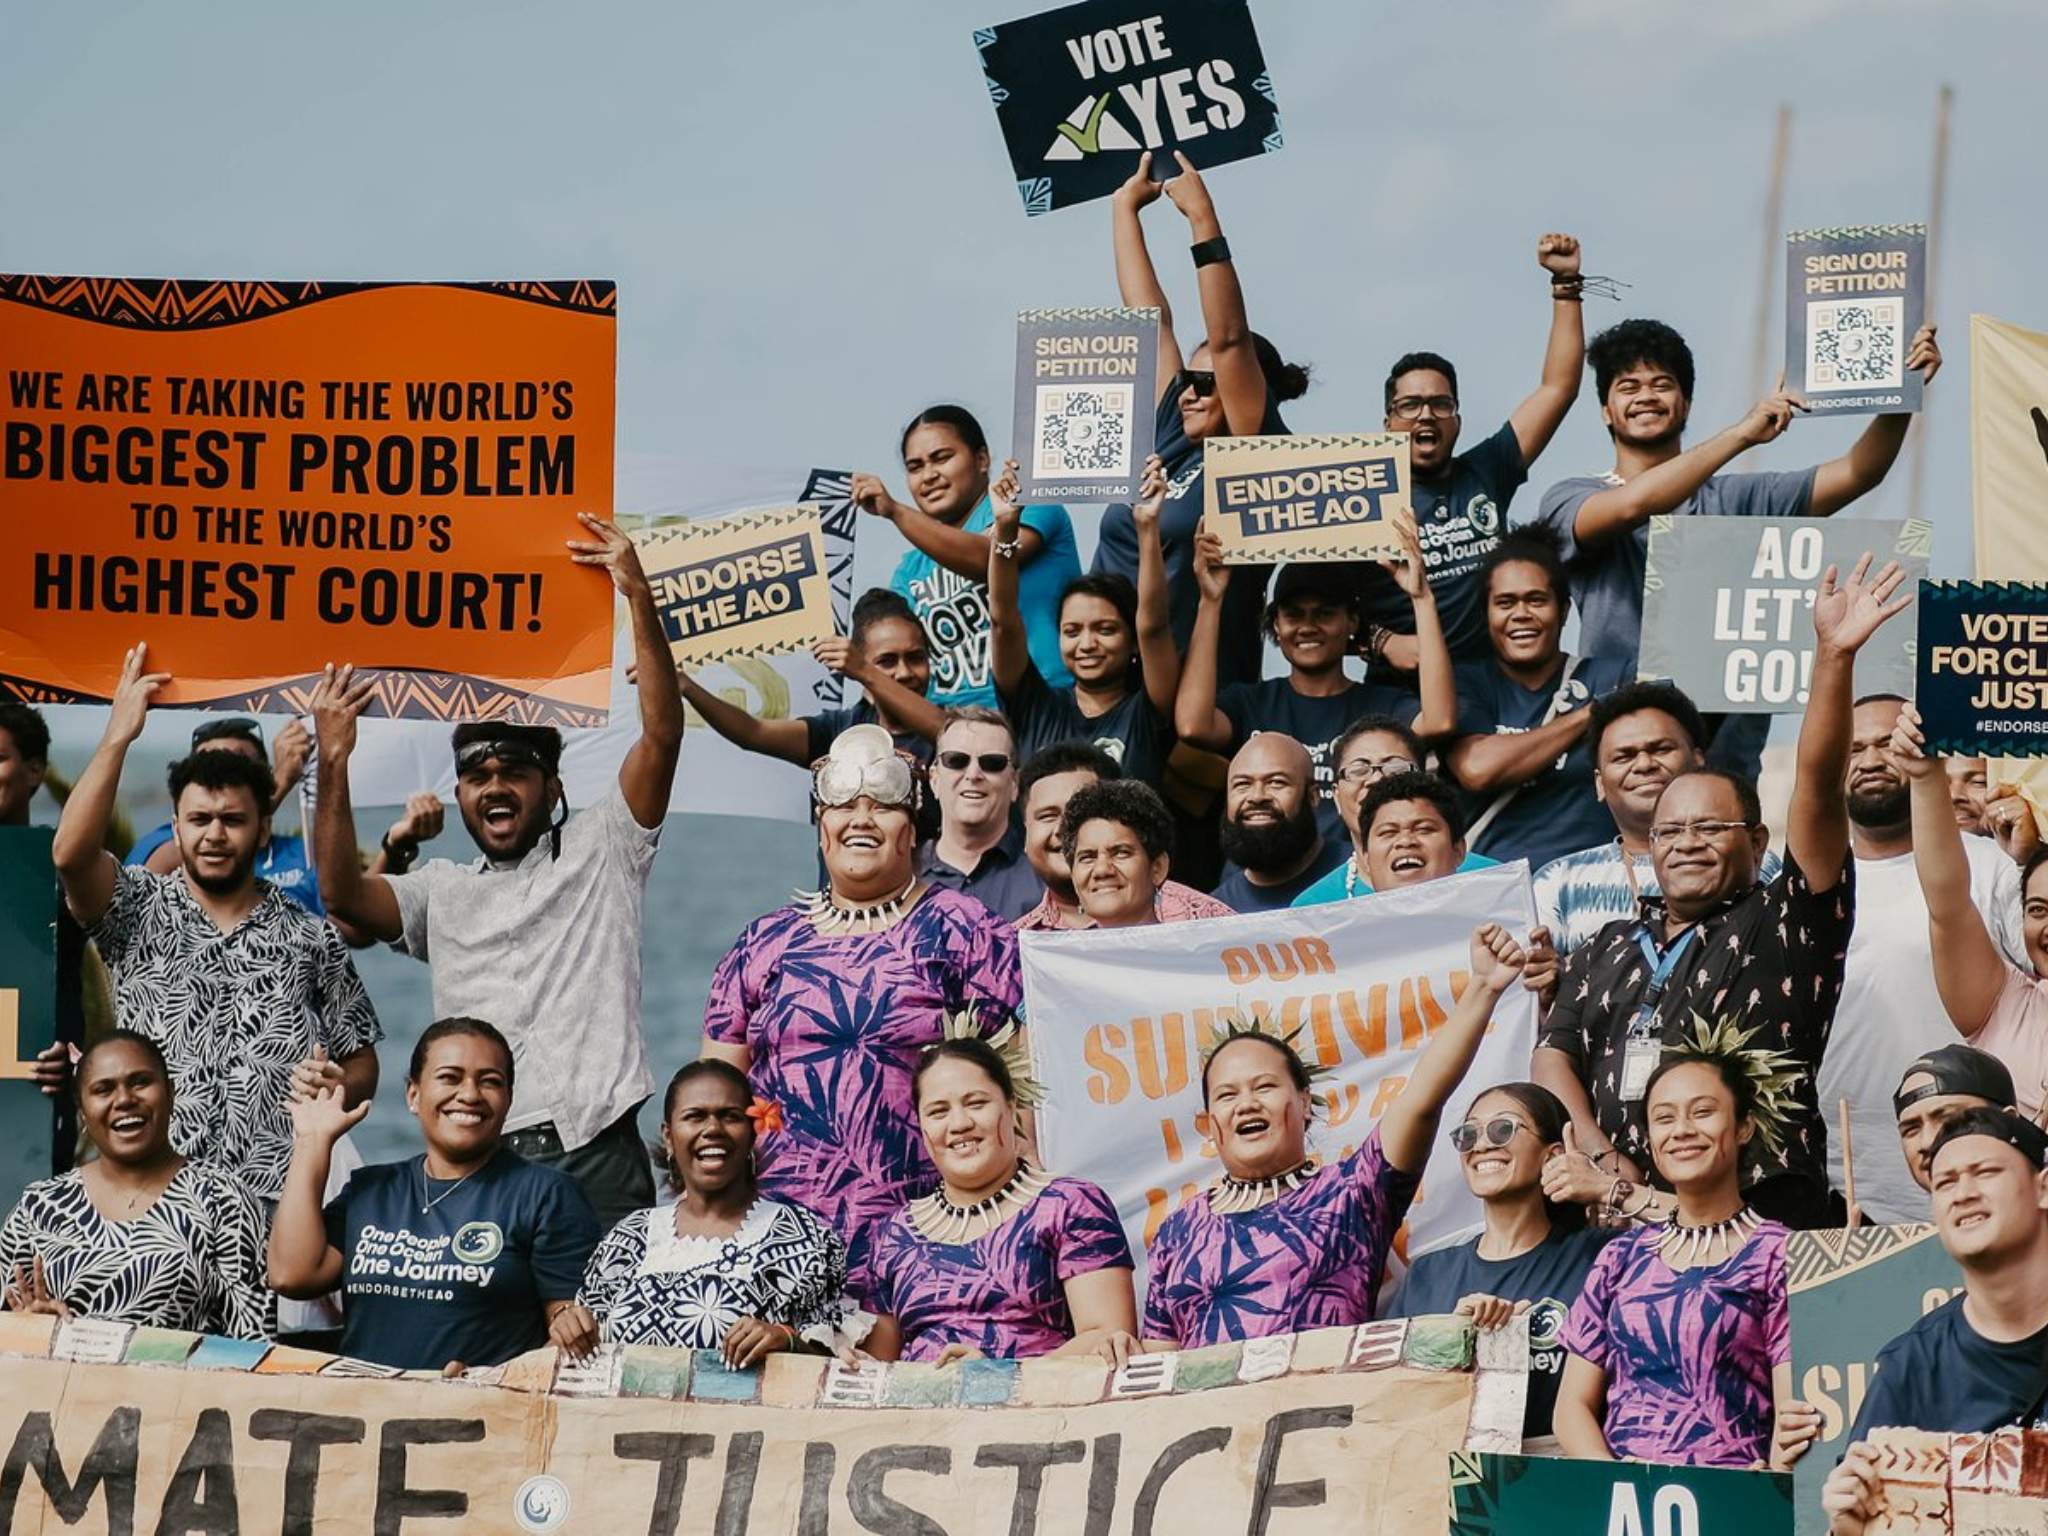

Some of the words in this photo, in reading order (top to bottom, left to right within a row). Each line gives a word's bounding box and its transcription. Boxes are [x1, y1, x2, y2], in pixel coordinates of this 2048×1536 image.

[1066, 15, 1172, 80] VOTE
[1118, 59, 1246, 149] YES
[1804, 254, 1857, 274] SIGN
[1859, 252, 1908, 270] OUR
[1805, 272, 1906, 294] PETITION
[1035, 336, 1089, 356] SIGN
[1090, 336, 1138, 355] OUR
[1036, 357, 1137, 377] PETITION
[9, 370, 63, 411] WE
[76, 373, 152, 414] ARE
[166, 377, 305, 419] TAKING
[320, 381, 391, 421] THE
[406, 380, 574, 422] WORLD'S
[4, 421, 266, 491] BIGGEST
[289, 433, 576, 497] PROBLEM
[1031, 485, 1129, 498] #ENDORSETHEAO
[1225, 463, 1389, 506] ENDORSE
[131, 502, 178, 541] TO
[193, 505, 264, 545] THE
[278, 509, 452, 554] WORLD'S
[1250, 504, 1317, 532] THE
[1323, 497, 1370, 524] AO
[1443, 537, 1502, 562] Journe
[1751, 526, 1824, 581] AO
[33, 552, 295, 622] HIGHEST
[317, 566, 543, 633] COURT!
[649, 543, 806, 607] ENDORSE
[670, 594, 740, 636] THE
[744, 582, 791, 619] AO
[1714, 588, 1817, 641] LET'
[1961, 614, 2048, 642] VOTE
[1724, 649, 1813, 704] GO!
[1931, 646, 2000, 675] FOR
[1220, 936, 1337, 986] OUR
[356, 1239, 388, 1255] One
[390, 1242, 443, 1262] Ocean
[361, 1225, 395, 1243] One
[395, 1229, 450, 1251] People
[351, 1254, 390, 1275] One
[393, 1258, 495, 1287] Journey
[0, 1407, 486, 1536] MATE
[1608, 1482, 1700, 1536] AO
